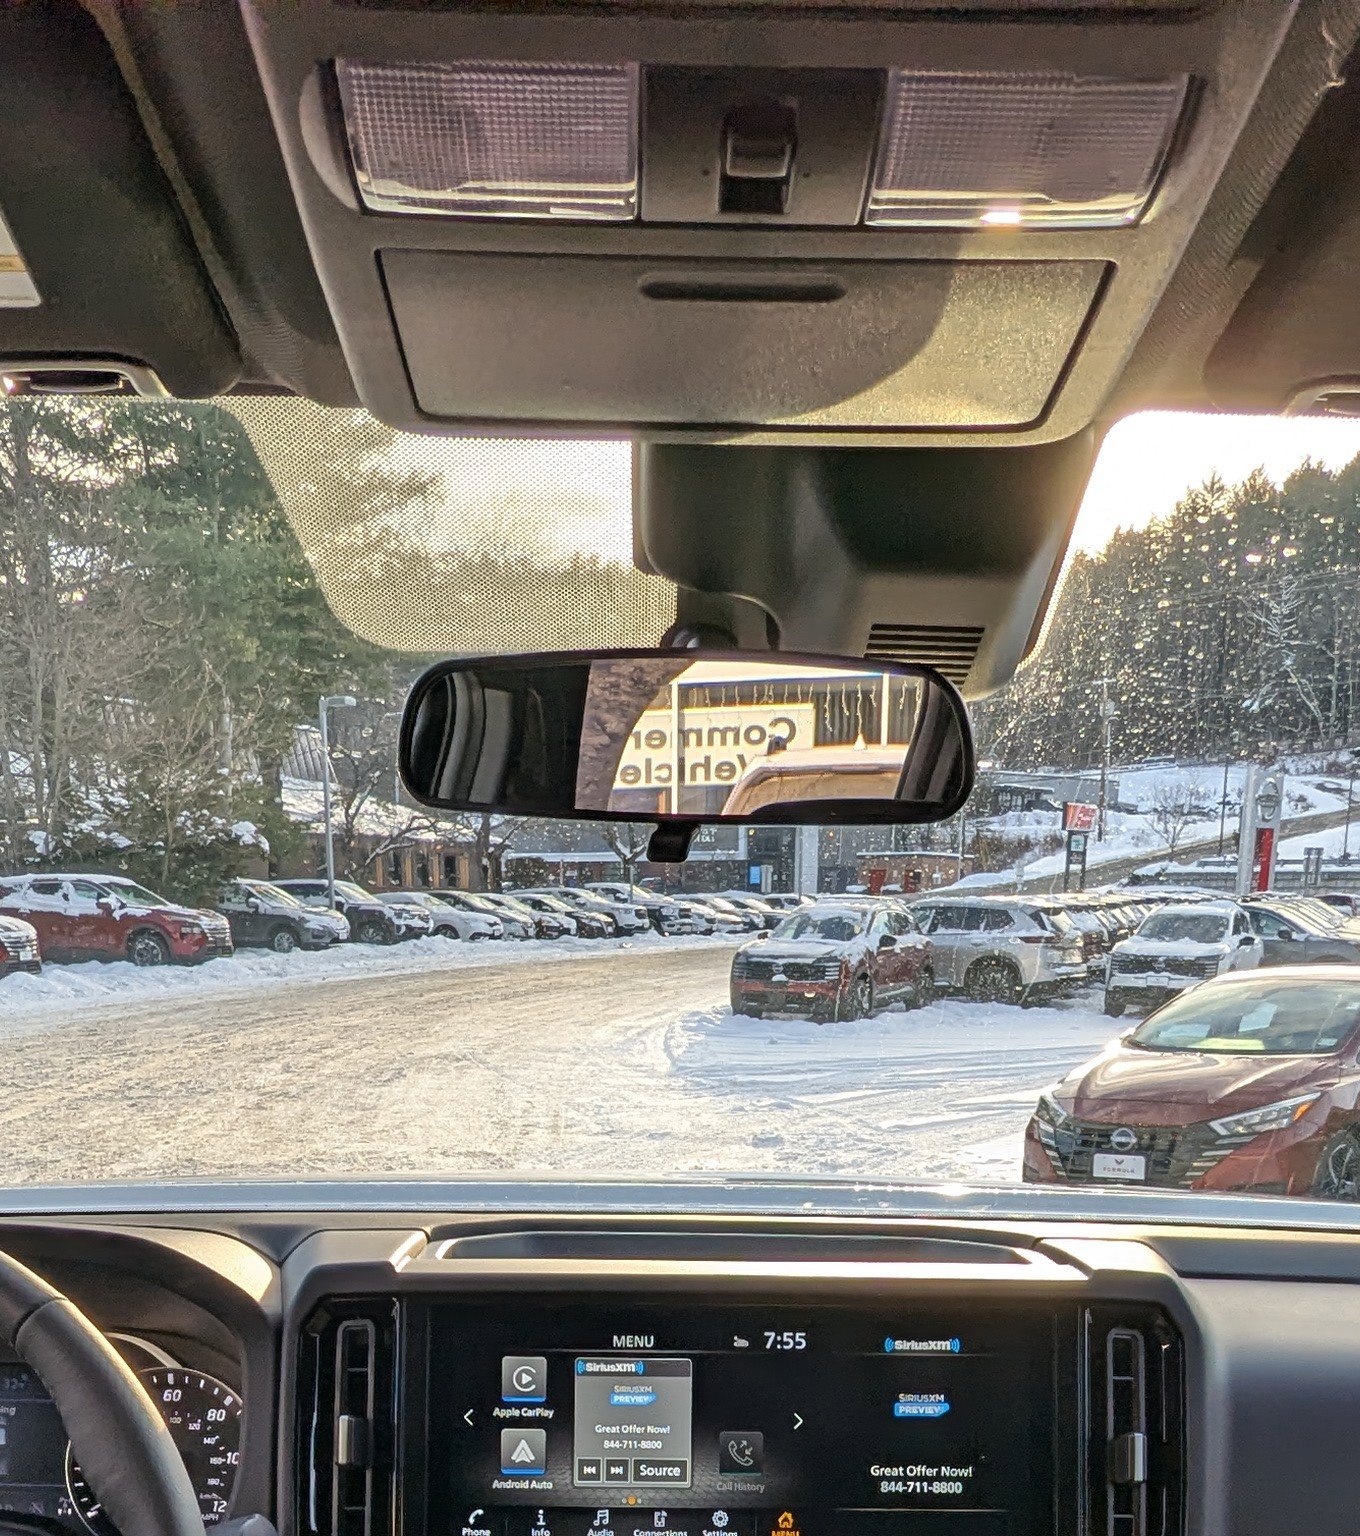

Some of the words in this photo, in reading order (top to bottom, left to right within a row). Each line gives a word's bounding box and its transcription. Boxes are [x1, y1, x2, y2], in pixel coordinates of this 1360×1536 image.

[612, 1335, 655, 1348] MENU
[763, 1331, 807, 1350] 7:55
[894, 1339, 952, 1351] SiriusXM
[585, 1361, 637, 1373] SiriusXM
[162, 1389, 182, 1402] 60
[613, 1385, 653, 1394] SIRIUSXM
[898, 1393, 945, 1403] SIRIUSXM
[206, 1408, 226, 1422] 80
[492, 1407, 520, 1419] Apple
[521, 1407, 554, 1419] CarPlay
[594, 1424, 620, 1434] Great
[621, 1424, 646, 1434] Offer
[646, 1424, 671, 1434] Now!
[203, 1437, 216, 1445] 140
[602, 1440, 663, 1451] 844-711-8800
[639, 1464, 681, 1478] Source
[869, 1465, 904, 1477] Great
[906, 1465, 939, 1477] Offer
[941, 1466, 973, 1478] Now!
[492, 1479, 529, 1490] Android
[530, 1480, 553, 1490] Auto
[716, 1481, 733, 1492] Call
[734, 1482, 765, 1494] History
[879, 1481, 963, 1494] 844-711-8800
